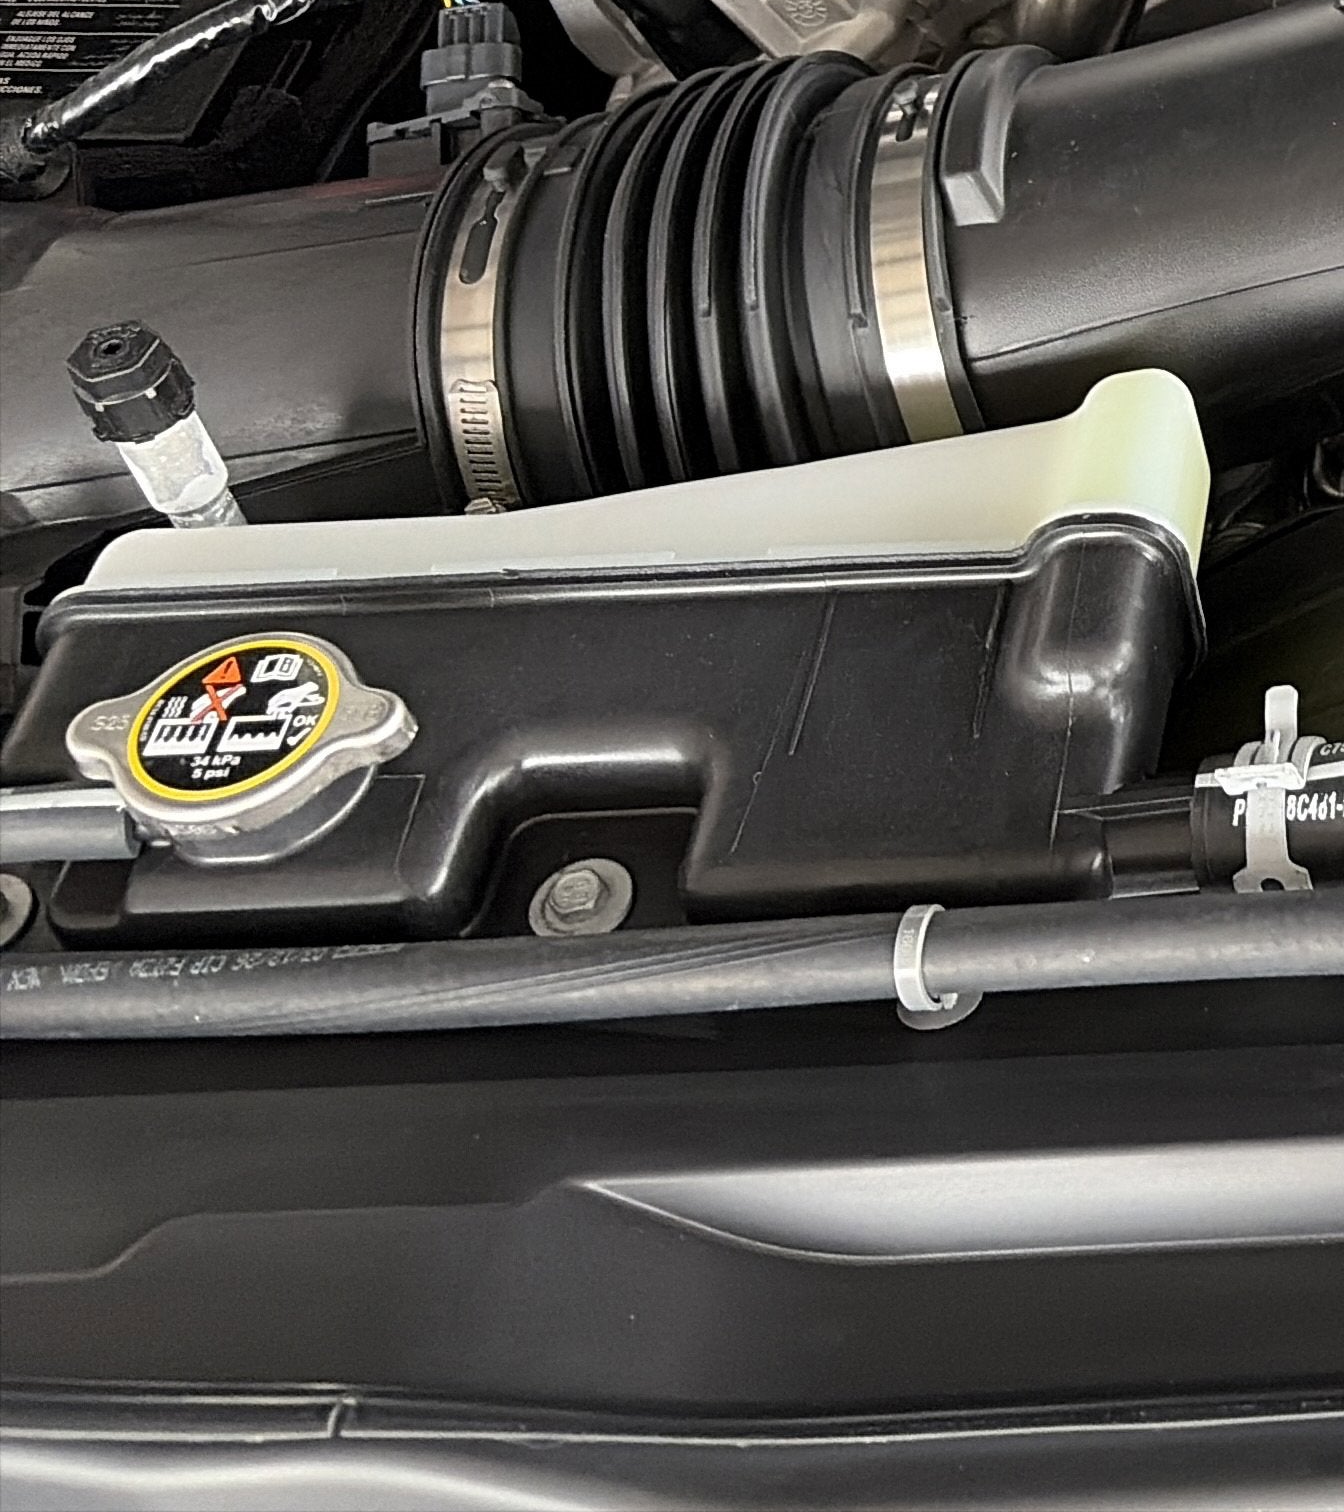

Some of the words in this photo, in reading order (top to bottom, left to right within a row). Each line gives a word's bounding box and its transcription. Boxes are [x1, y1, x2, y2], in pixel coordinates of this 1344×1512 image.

[292, 713, 319, 729] OK
[189, 754, 210, 768] 34
[211, 754, 241, 768] kPa
[191, 767, 201, 780] 5
[203, 766, 230, 780] psi
